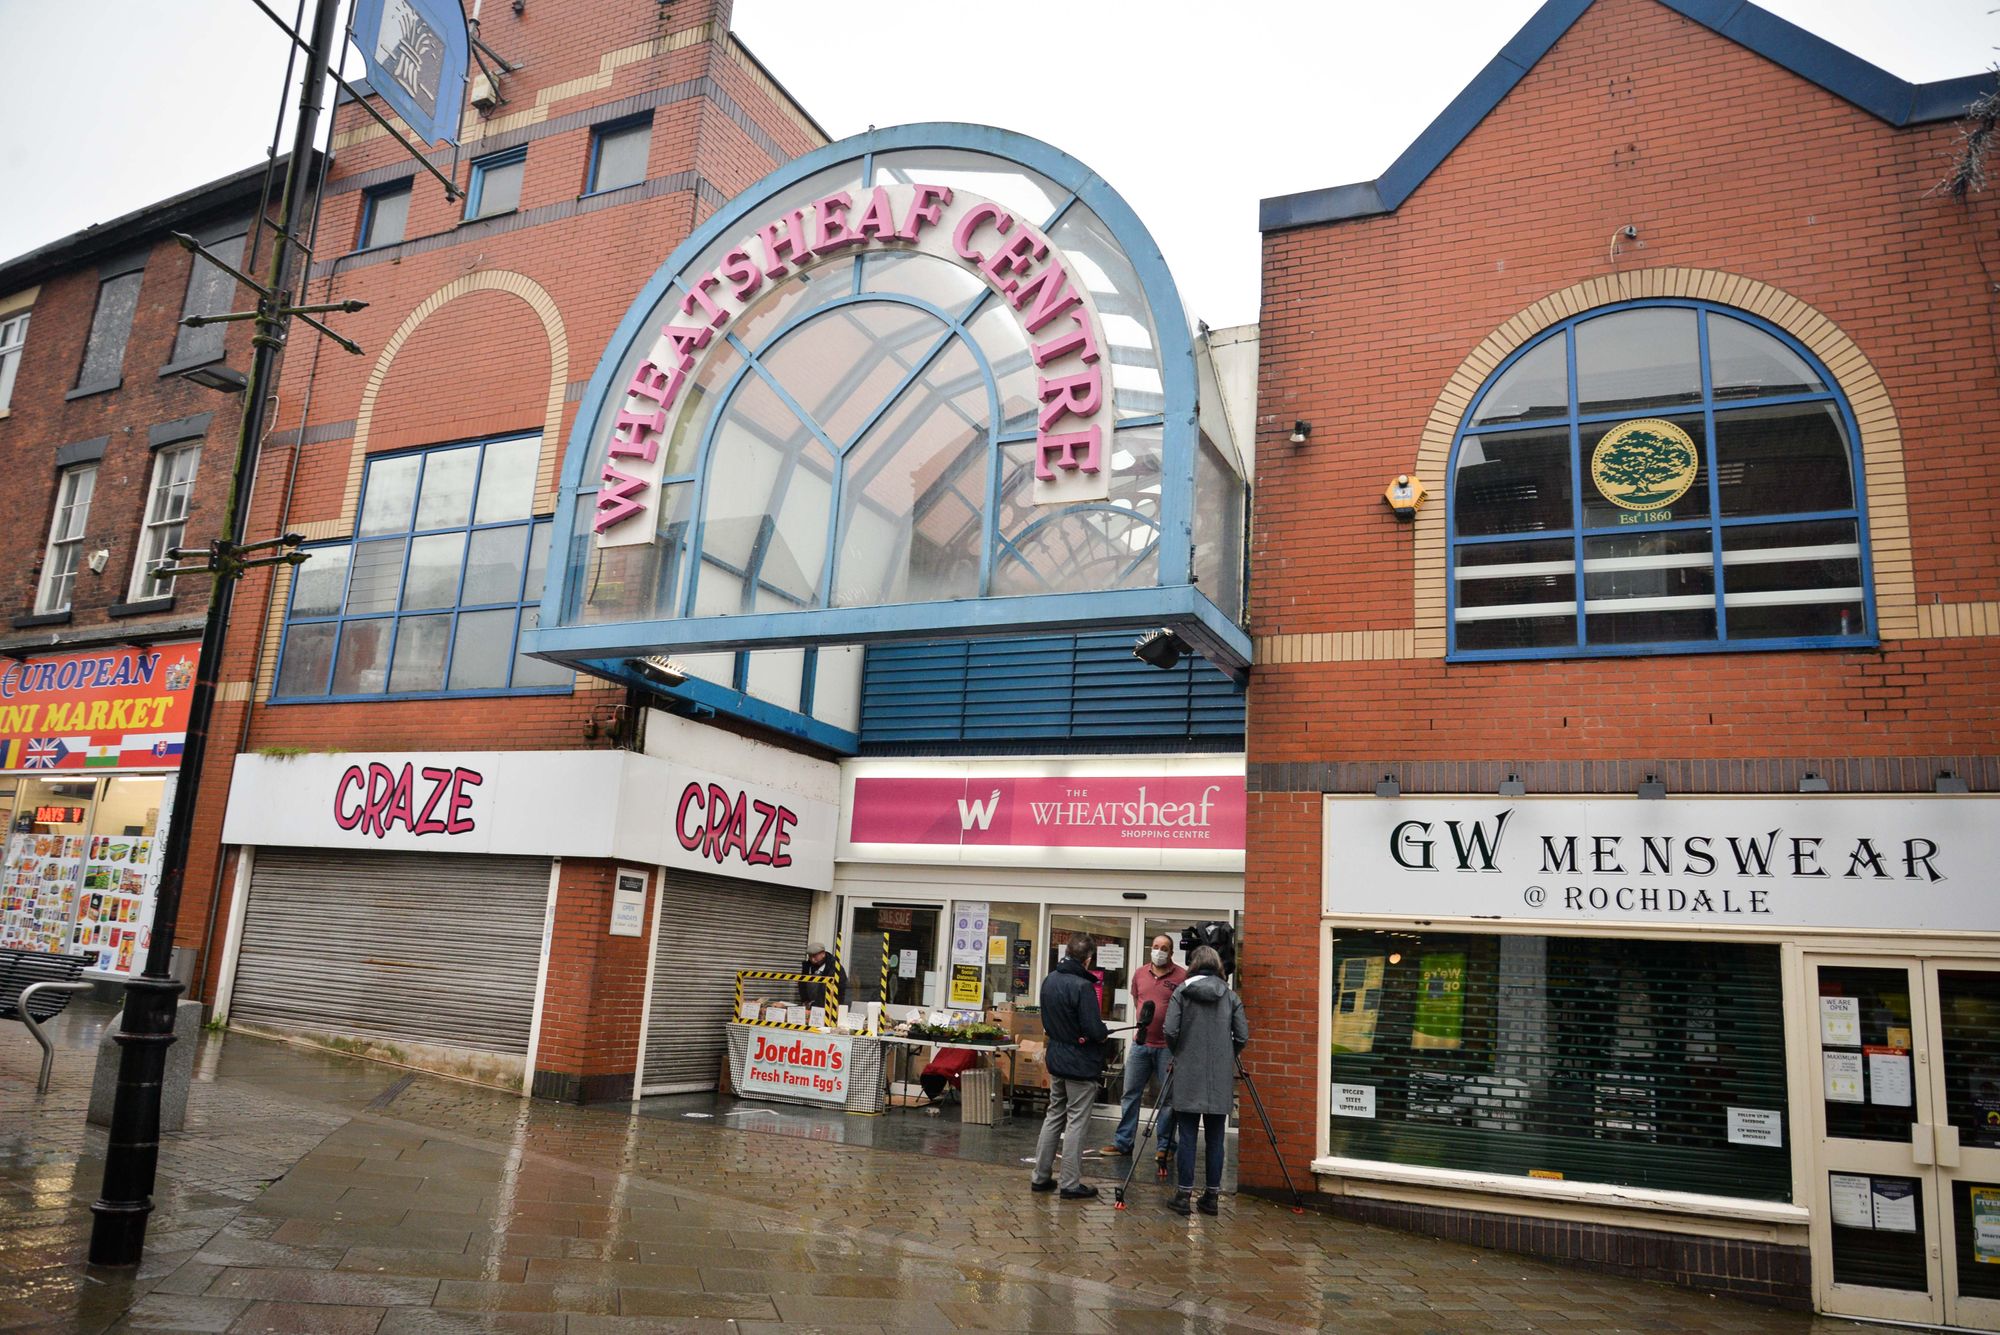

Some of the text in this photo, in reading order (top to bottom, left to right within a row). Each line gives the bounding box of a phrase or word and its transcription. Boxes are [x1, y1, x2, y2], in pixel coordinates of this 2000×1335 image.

[593, 183, 1103, 535] WHEATSHEAF CENTRE
[1644, 511, 1672, 522] 1860
[40, 696, 174, 732] MARKET
[334, 761, 483, 839] CRAZE
[1030, 785, 1221, 827] WHEATsheaf
[1066, 789, 1088, 797] THE
[36, 807, 65, 822] DAYS
[676, 781, 798, 868] CRAZE
[1121, 830, 1210, 839] SHOPPING CENTRE
[1390, 809, 1948, 884] GW MENSWEAR
[1523, 886, 1772, 915] @ ROCHDALE
[753, 1036, 843, 1070] Jordan's
[750, 1067, 842, 1093] Fresh Farm Egg's
